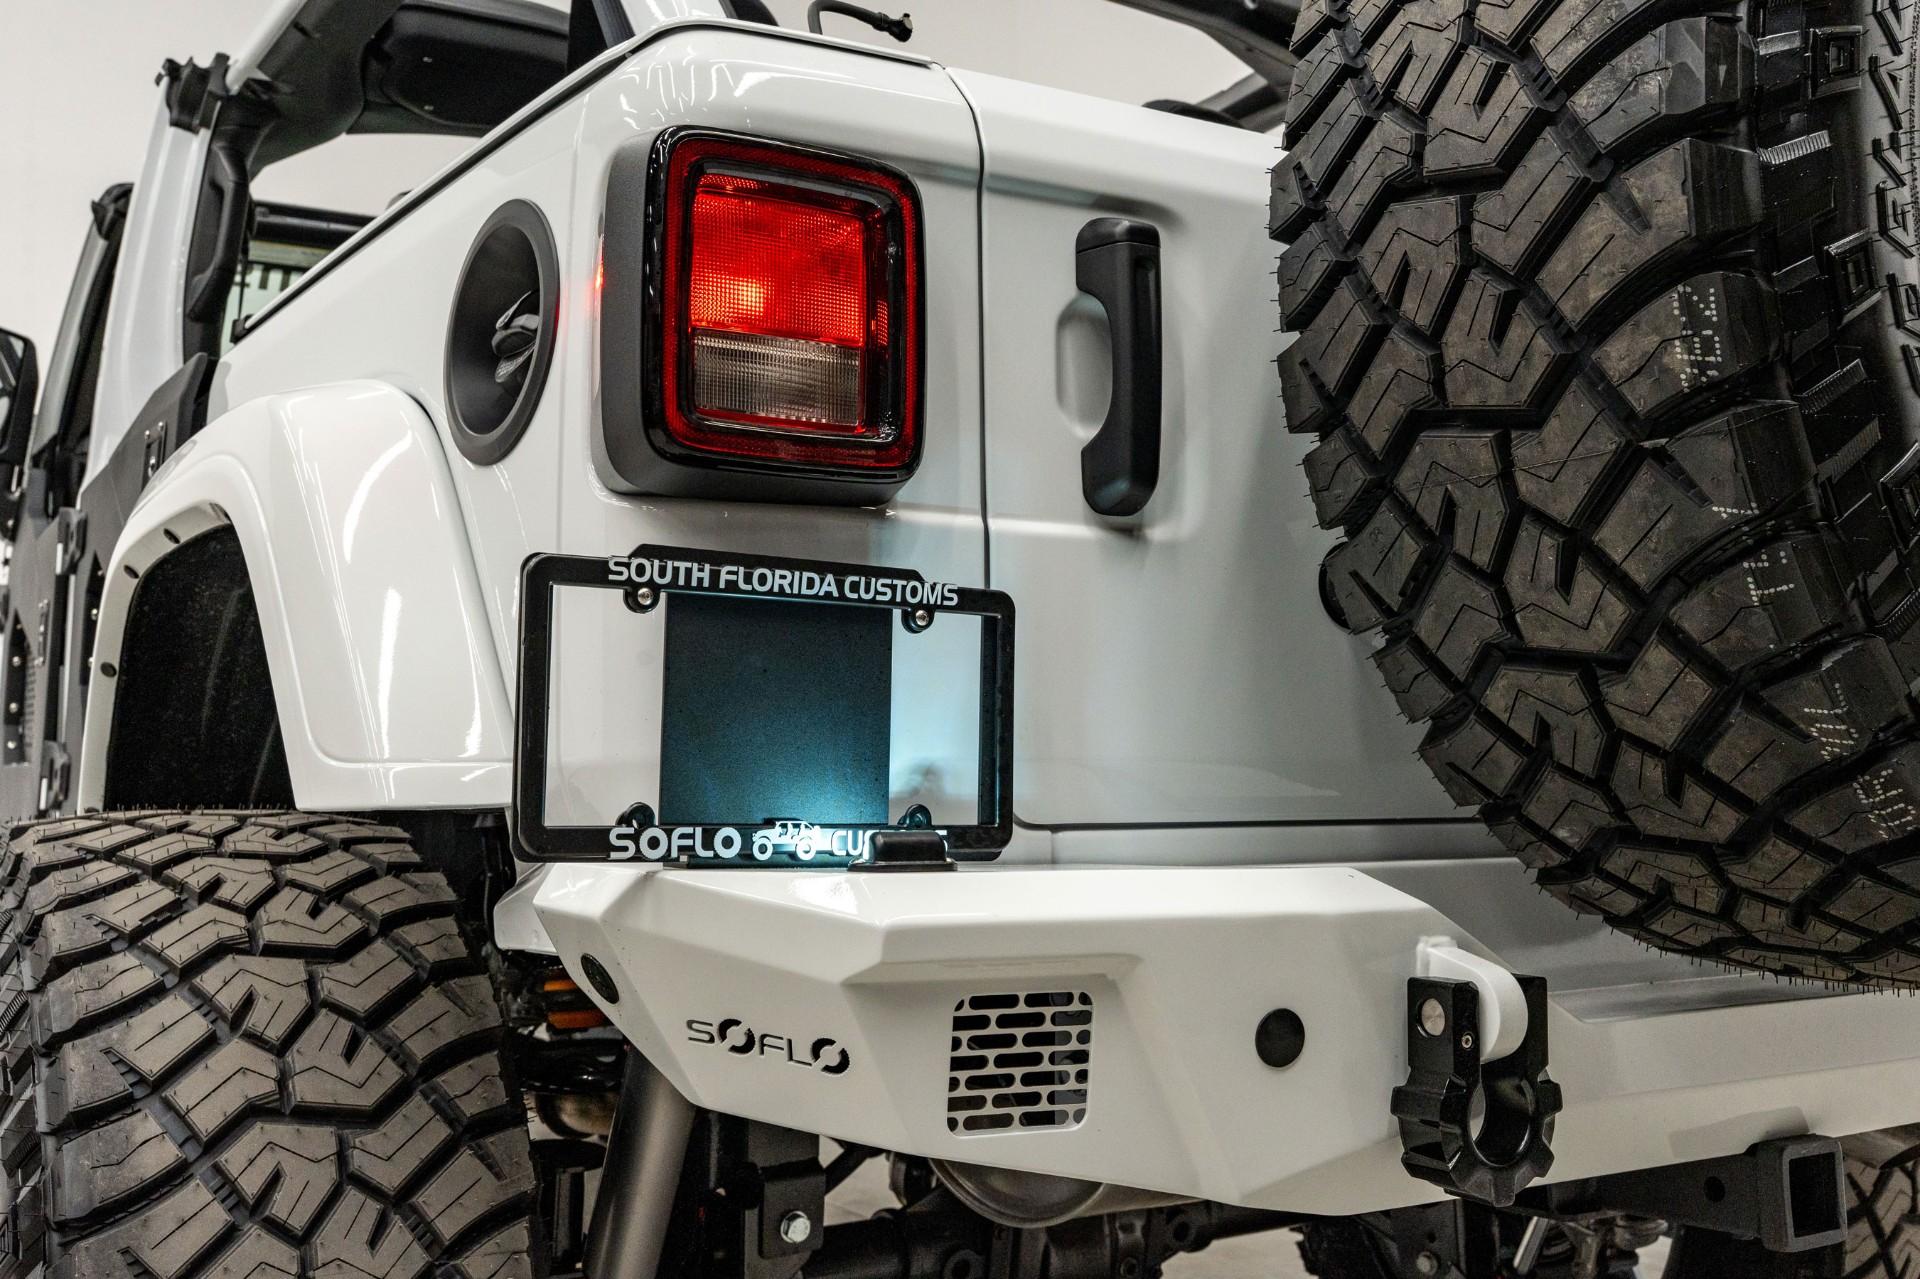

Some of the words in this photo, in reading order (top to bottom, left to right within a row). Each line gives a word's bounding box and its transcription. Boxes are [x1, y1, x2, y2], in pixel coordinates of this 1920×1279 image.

[608, 555, 710, 587] SOUTH
[719, 565, 839, 597] FLORIDA
[844, 575, 959, 606] CUSTOMS
[608, 826, 742, 860] SOFLO
[686, 1018, 850, 1075] SOFLO
